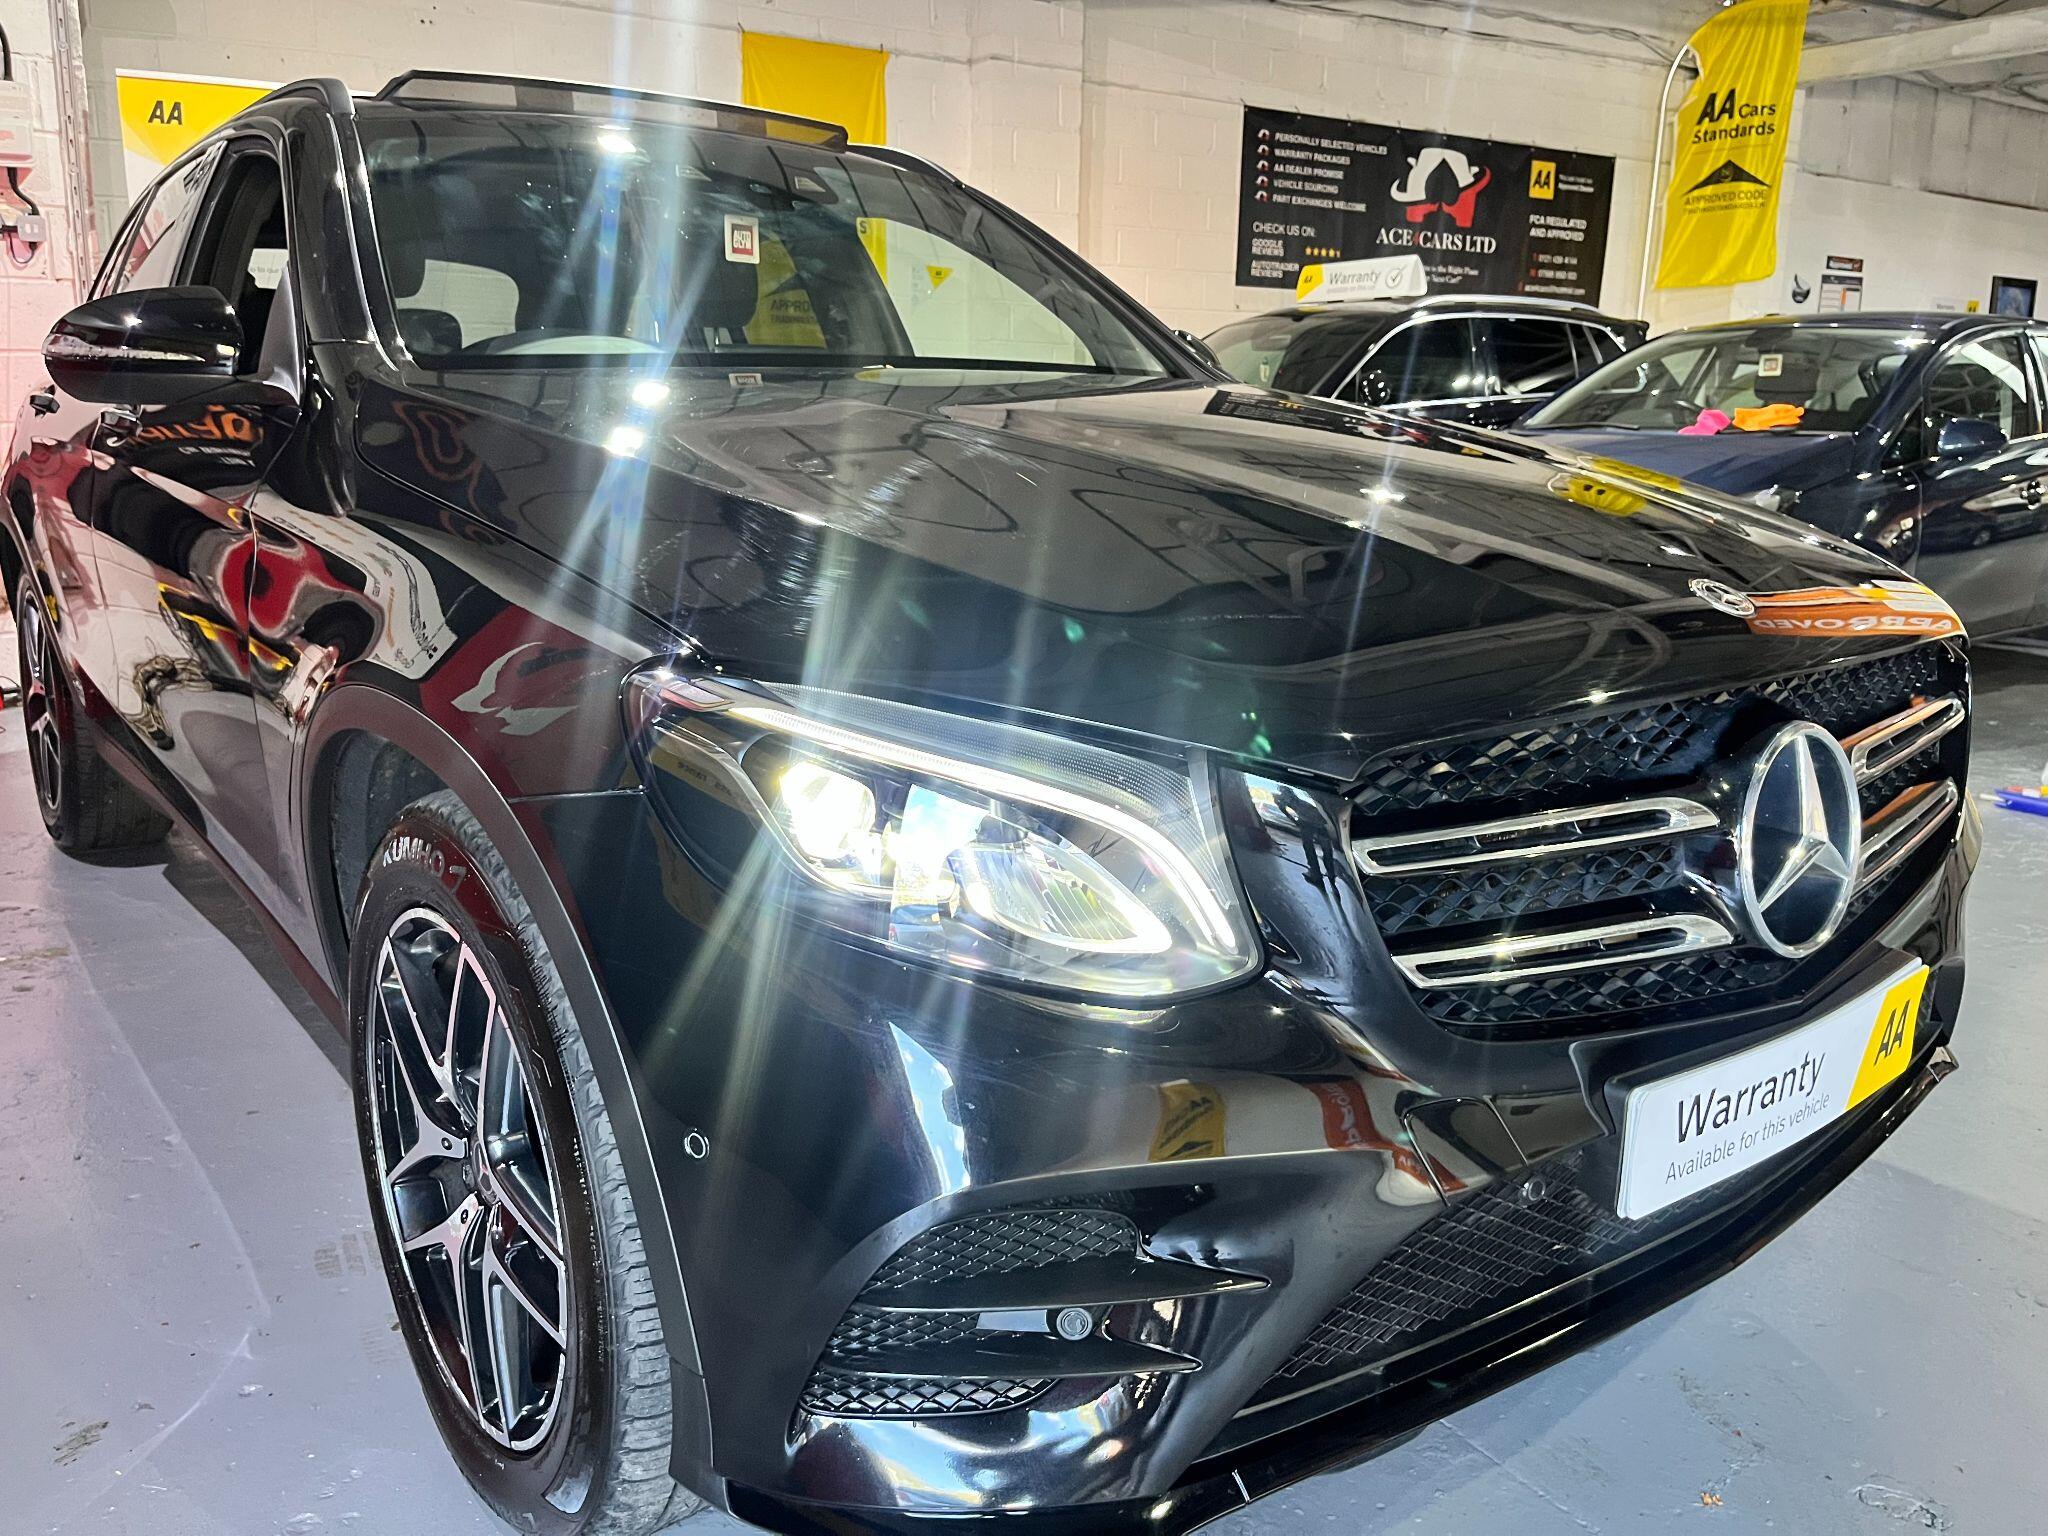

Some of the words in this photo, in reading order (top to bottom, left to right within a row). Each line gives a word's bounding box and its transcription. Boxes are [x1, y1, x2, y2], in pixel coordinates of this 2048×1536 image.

[148, 100, 183, 126] AA
[1697, 88, 1736, 125] AA
[1738, 103, 1776, 119] Cars
[1692, 121, 1775, 144] Standards
[1274, 132, 1320, 146] PERSONALLY
[1320, 138, 1355, 151] SELECTED
[1355, 143, 1388, 155] VEHICLES
[1274, 148, 1313, 160] WARRANTY
[1313, 153, 1351, 165] PACKAGES
[1285, 165, 1312, 176] DEALER
[1313, 168, 1344, 180] PROMISE
[1532, 169, 1551, 190] AA
[1273, 179, 1304, 190] VEHICLE
[1304, 182, 1339, 194] SOURCING
[1272, 194, 1291, 204] PART
[1252, 221, 1286, 235] CHECK
[1287, 225, 1300, 236] US
[1529, 214, 1545, 225] FCA
[1545, 216, 1587, 230] REGULATED
[733, 230, 752, 241] AUTO
[1529, 227, 1547, 238] AND
[1547, 229, 1585, 242] APPROVED
[1252, 238, 1283, 248] GOOGLE
[1465, 235, 1497, 254] LTD
[1251, 247, 1284, 257] REVIEWS
[1250, 269, 1283, 279] REVIEWS
[1329, 270, 1382, 285] Warranty
[382, 836, 445, 878] KUMHO
[1676, 1051, 1826, 1143] Warranty
[1874, 999, 1910, 1067] AA
[1665, 1138, 1736, 1184] Available
[1739, 1125, 1760, 1153] for
[1761, 1116, 1785, 1142] this
[1788, 1092, 1831, 1128] vehicle
